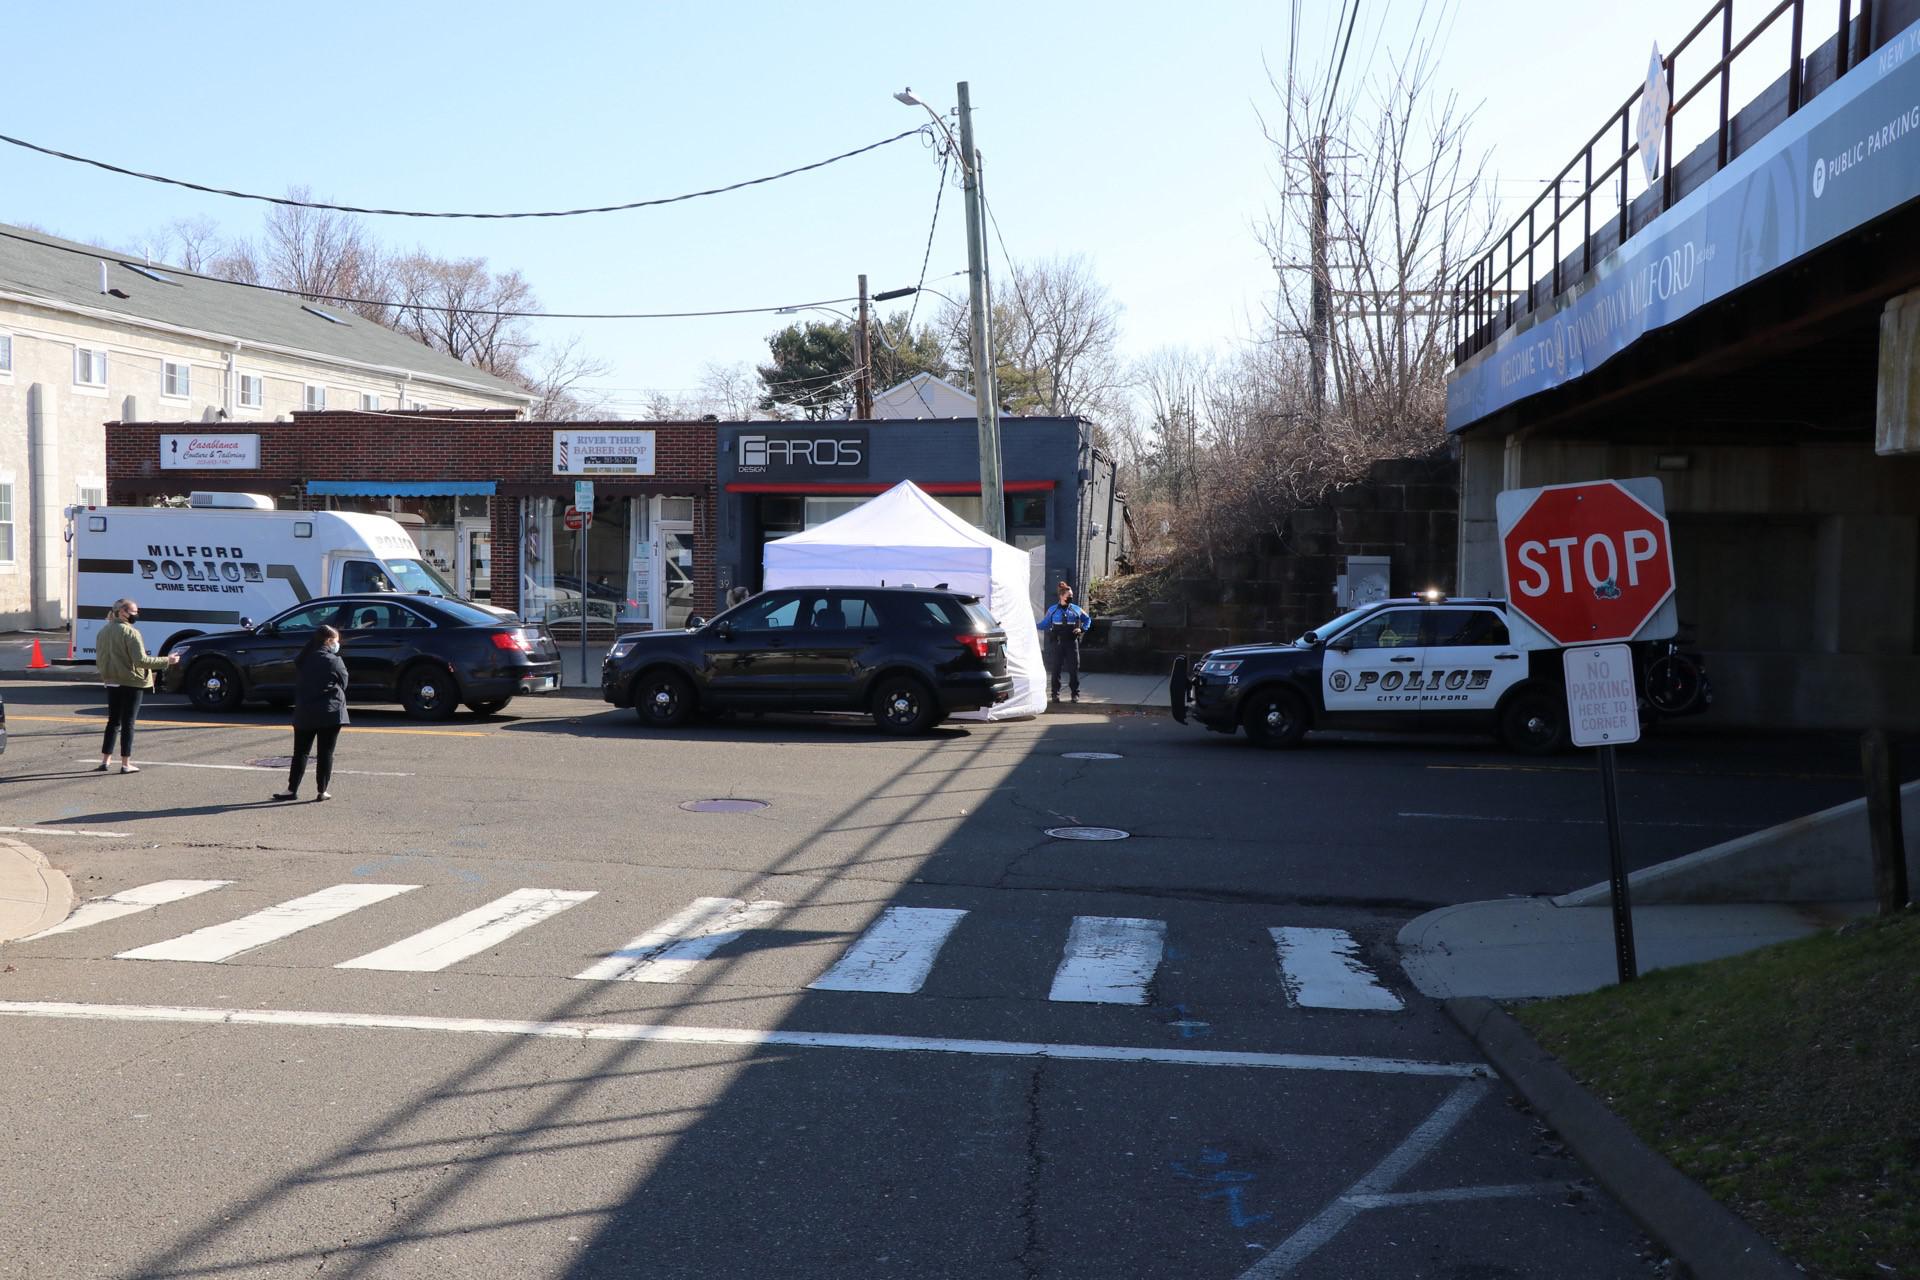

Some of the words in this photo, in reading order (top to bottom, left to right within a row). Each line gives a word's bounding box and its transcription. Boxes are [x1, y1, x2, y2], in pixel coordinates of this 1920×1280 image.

[1878, 39, 1905, 75] NEW
[1828, 141, 1864, 180] PUBLIC
[1867, 105, 1920, 157] PARKING
[1538, 337, 1554, 371] TO
[1630, 241, 1695, 319] MILFORD
[188, 438, 241, 451] Casablanca
[576, 435, 607, 445] RIVER
[608, 435, 642, 445] THREE
[573, 446, 615, 455] BARBER
[617, 446, 647, 455] SHOP
[739, 435, 862, 466] FAROS
[147, 544, 243, 559] MILFORD
[137, 559, 264, 583] POLICE
[1518, 529, 1658, 597] STOP
[155, 582, 185, 592] CRIME
[187, 583, 219, 593] SCENE
[221, 585, 244, 594] UNIT
[1228, 675, 1240, 685] 15
[1586, 660, 1610, 680] NO
[1354, 669, 1493, 692] POLICE
[1572, 680, 1630, 700] PARKING
[1579, 702, 1608, 717] HERE
[1613, 701, 1627, 713] TO
[1581, 715, 1629, 731] CORNER
